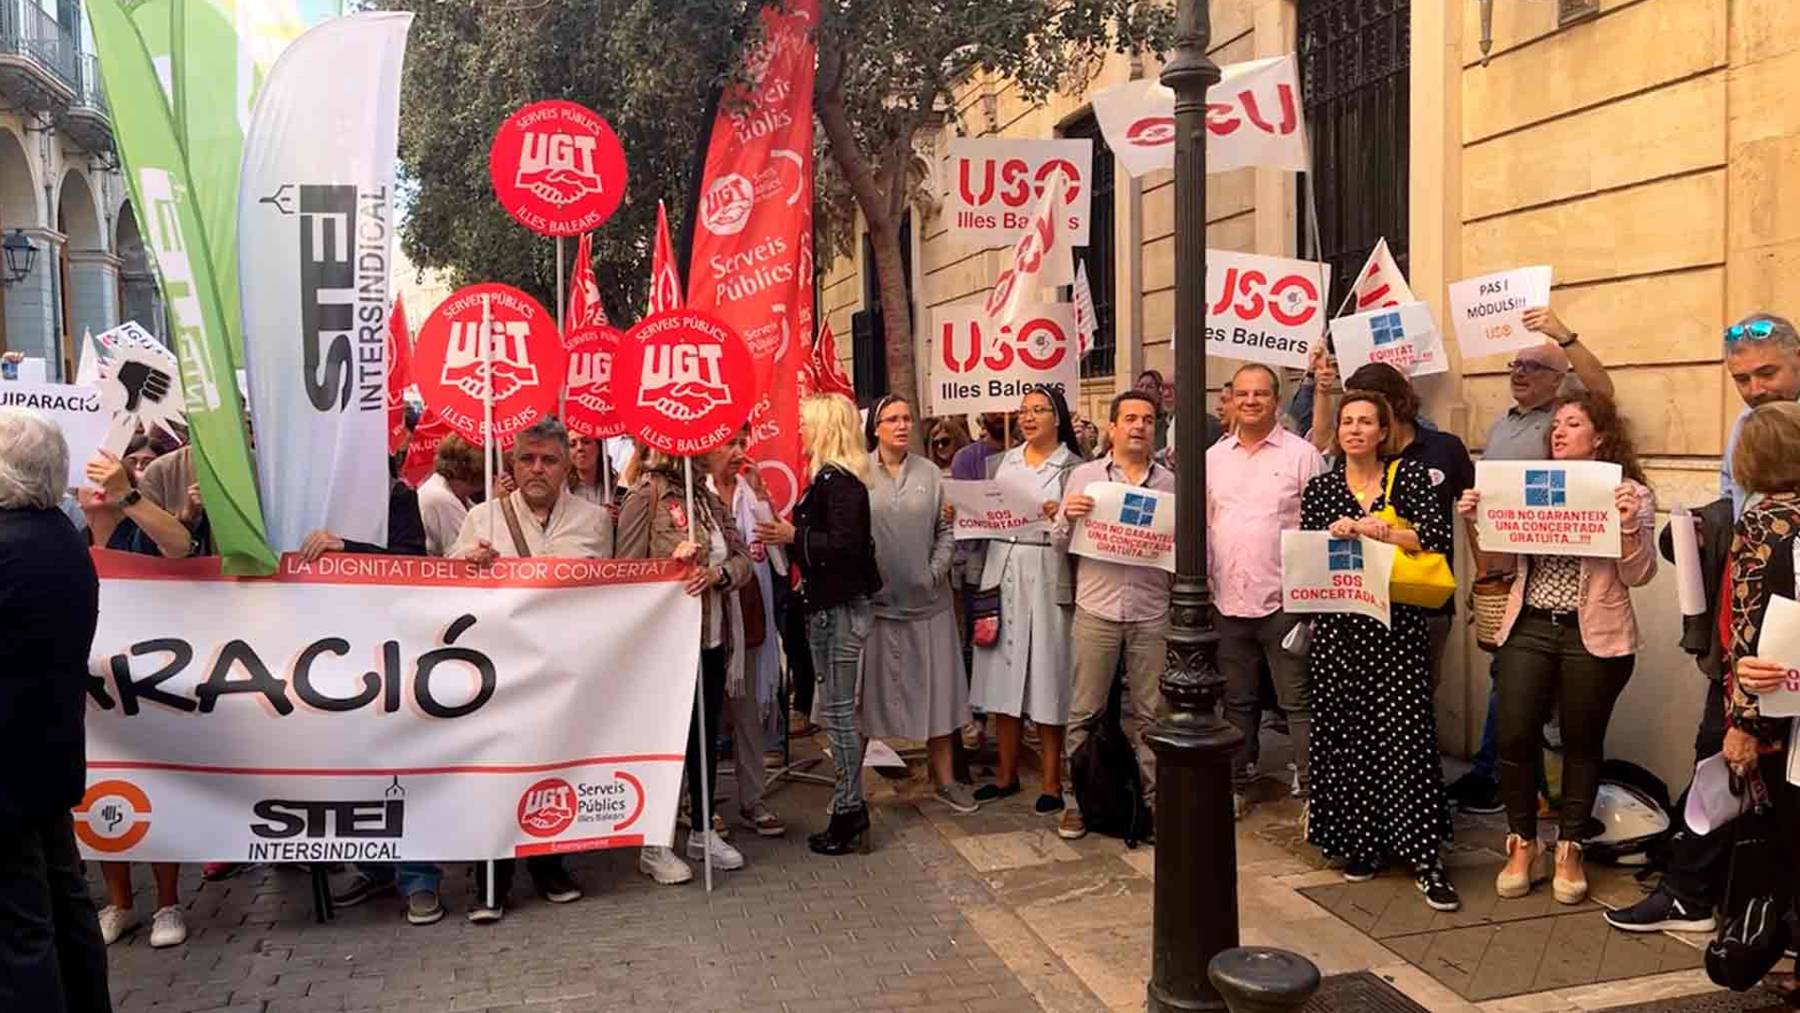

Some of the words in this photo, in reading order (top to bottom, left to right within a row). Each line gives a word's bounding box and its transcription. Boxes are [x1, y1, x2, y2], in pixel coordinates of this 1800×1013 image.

[517, 107, 558, 131] SERVEIS
[561, 107, 602, 136] PÚBLICS
[520, 132, 597, 176] UGT
[960, 158, 1081, 207] USO
[704, 178, 748, 216] UGT
[515, 205, 546, 230] ILLES
[549, 210, 601, 233] BALEARS
[957, 211, 997, 229] Illes
[710, 236, 788, 279] Serveis
[300, 184, 357, 412] STEI
[715, 262, 794, 306] Públics
[1480, 280, 1501, 296] PAS
[358, 186, 386, 412] INTERSINDICAL
[491, 291, 536, 320] PÚBLICS
[635, 316, 681, 343] SERVEIS
[683, 314, 729, 343] PÚBLICS
[1232, 326, 1309, 354] Balears
[446, 321, 530, 367] UGT
[1369, 344, 1413, 362] EQUITAT
[567, 352, 613, 388] UG
[642, 343, 723, 389] UGT
[942, 382, 982, 400] Illes
[441, 405, 474, 432] ILLES
[567, 415, 594, 435] ILLES
[639, 425, 673, 449] ILLES
[677, 423, 732, 451] BALEARS
[986, 509, 1012, 520] SOS
[1495, 520, 1520, 531] UNA
[1522, 521, 1606, 533] CONCERTADA
[1518, 510, 1535, 520] NO
[1537, 510, 1609, 522] GARANTEIX
[1088, 530, 1108, 541] UNA
[1109, 534, 1173, 552] CONCERTADA
[1109, 524, 1124, 534] NO
[287, 556, 313, 576] LA
[319, 557, 413, 578] DIGNITAT
[420, 561, 458, 579] DEL
[465, 560, 548, 580] SECTOR
[554, 560, 669, 581] CONCERTAT
[1332, 574, 1363, 588] SOS
[525, 785, 570, 815] UGT
[578, 781, 625, 797] Serveis
[249, 797, 405, 839] STEI
[578, 798, 626, 814] Públics
[248, 842, 402, 861] INTERSINDICAL
